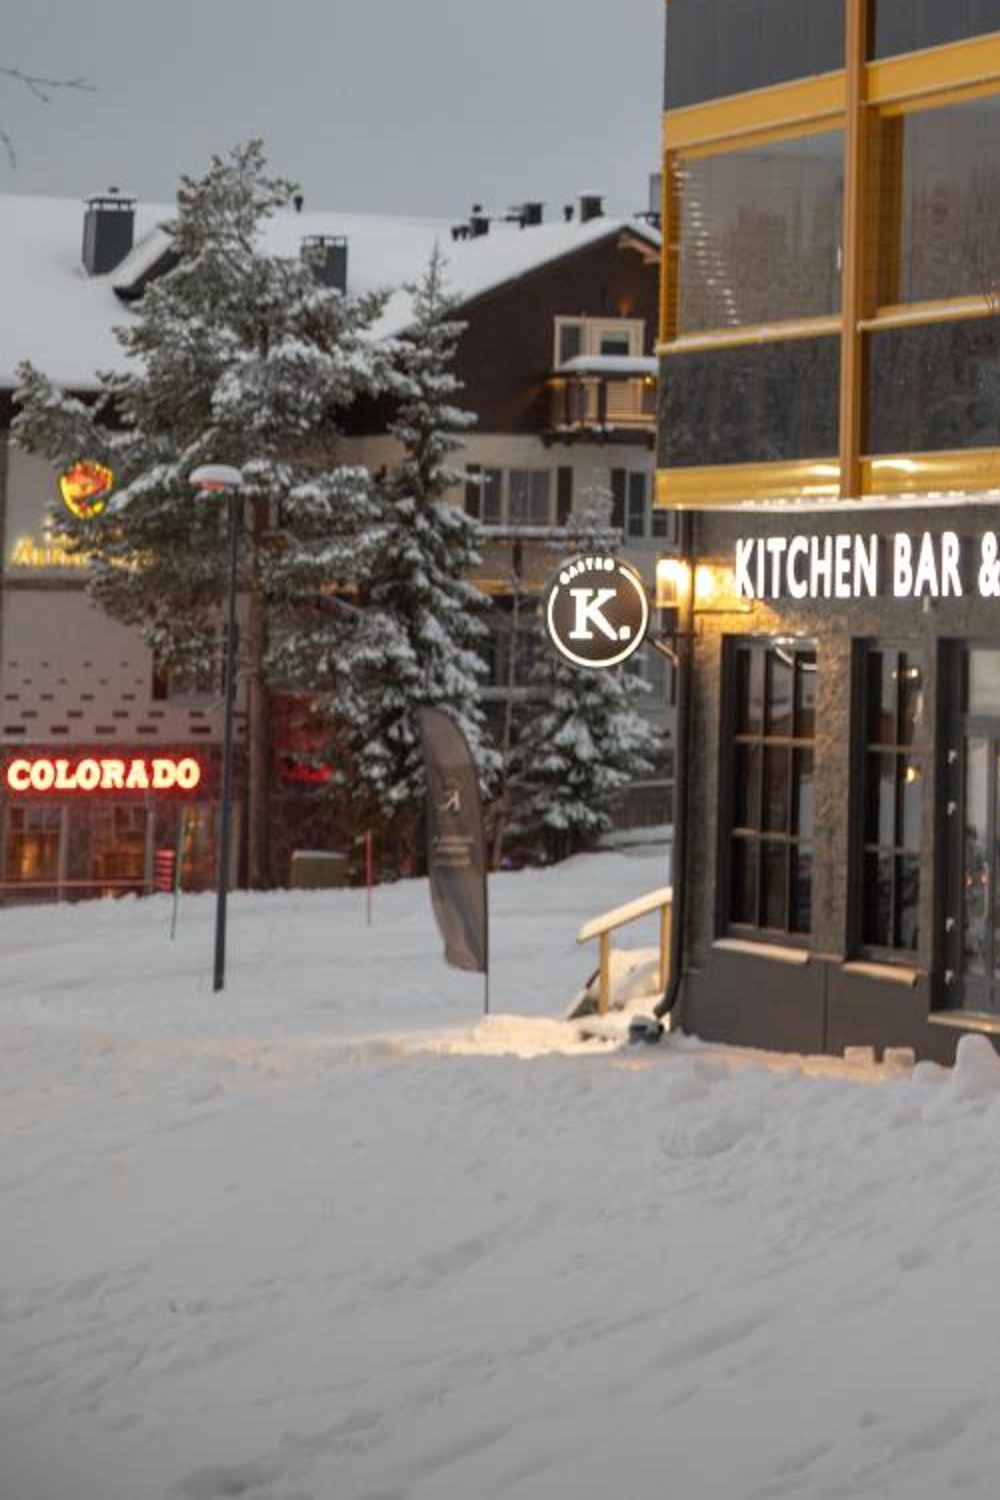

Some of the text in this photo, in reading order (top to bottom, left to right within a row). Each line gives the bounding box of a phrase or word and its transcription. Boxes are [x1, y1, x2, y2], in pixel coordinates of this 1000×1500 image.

[734, 535, 878, 600] KITCHEN
[893, 531, 963, 598] BAR
[568, 587, 632, 641] K.
[7, 758, 201, 790] COLORADO
